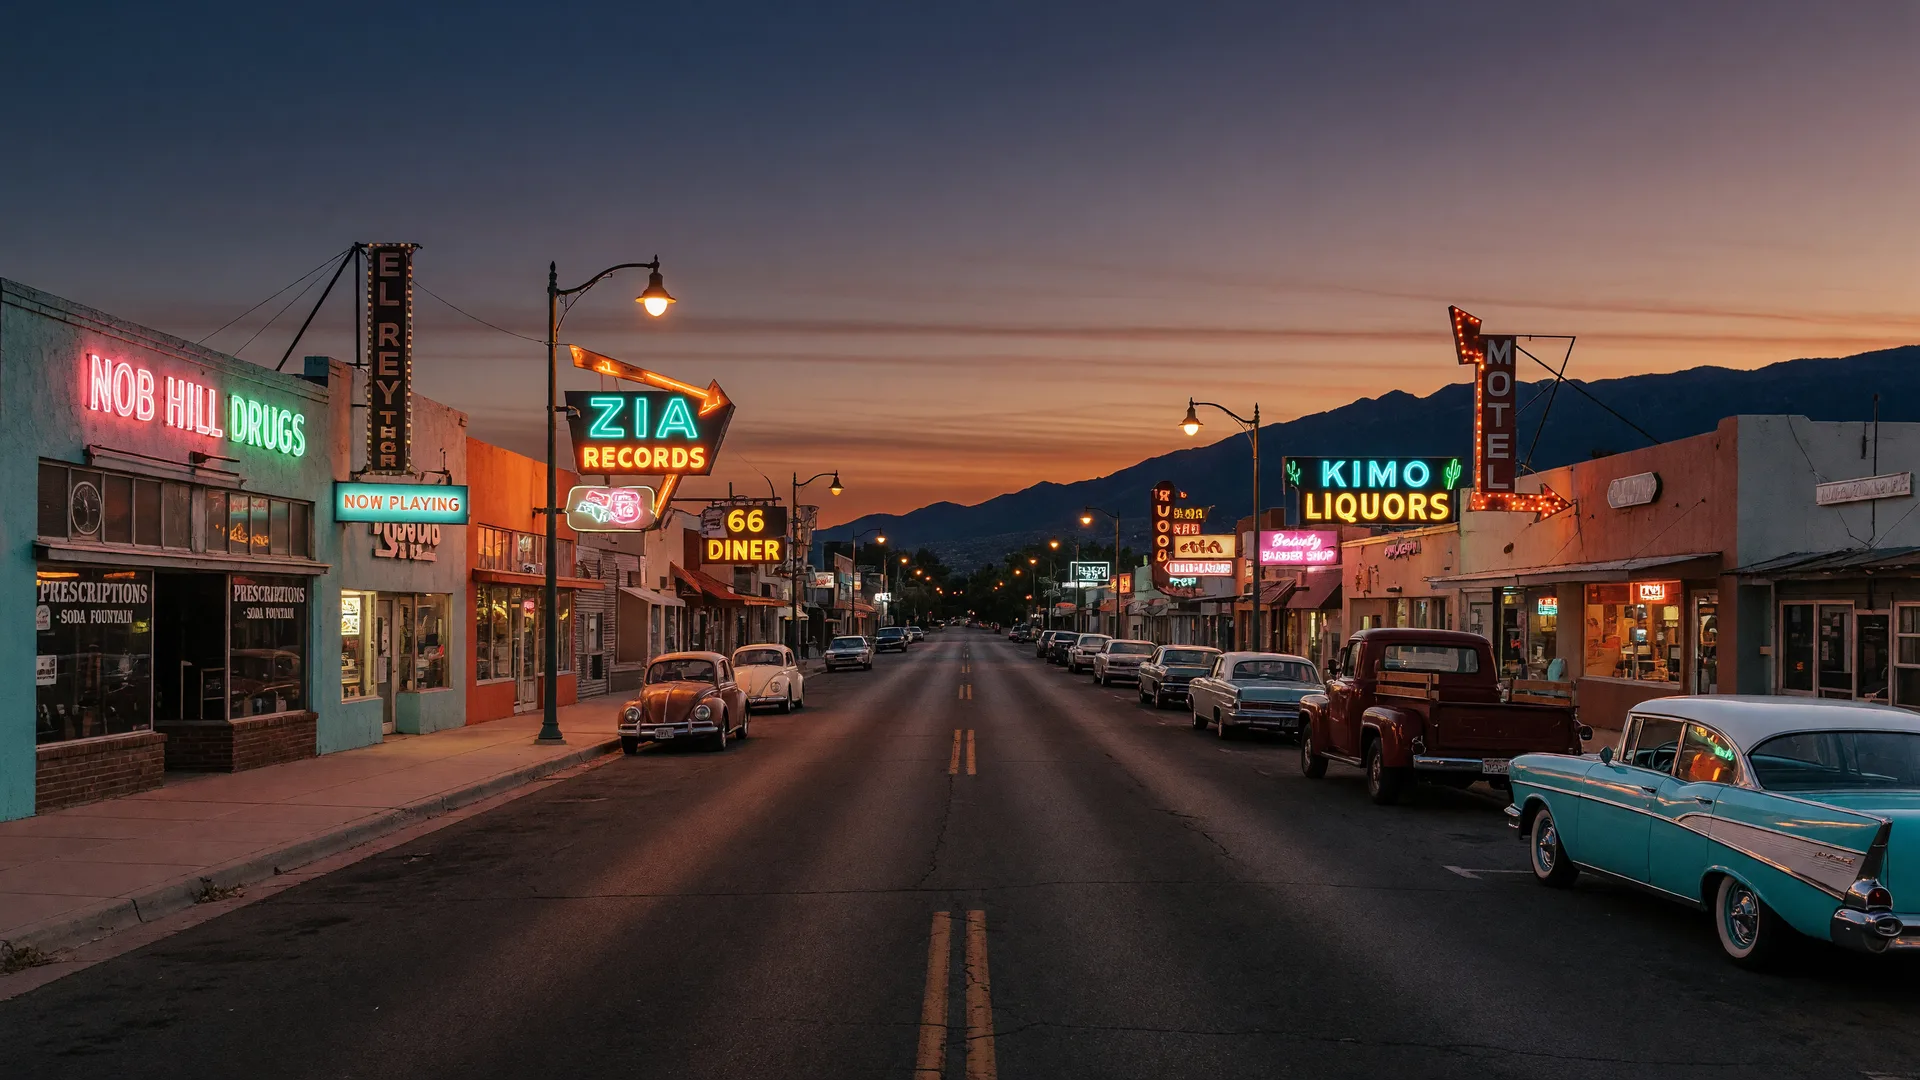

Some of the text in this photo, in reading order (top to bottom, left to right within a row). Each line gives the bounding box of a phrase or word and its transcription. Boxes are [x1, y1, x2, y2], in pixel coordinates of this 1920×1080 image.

[379, 252, 400, 307] EL
[376, 322, 402, 405] REY
[90, 354, 306, 457] NOB HILL DRUGS
[1486, 339, 1512, 489] MOTEL
[590, 397, 698, 438] ZIA
[583, 446, 705, 468] RECORDS
[1322, 460, 1430, 488] KIMO
[344, 494, 460, 512] NOW PLAYING
[1306, 492, 1449, 523] LIQUORS
[727, 509, 765, 532] 66
[708, 539, 780, 560] DINER
[1271, 533, 1322, 551] Beauty
[1262, 550, 1335, 562] BARBER SHOP
[39, 581, 148, 604] PRESCRIPTIONS
[233, 584, 305, 603] PRESCRIPTIONS
[60, 609, 86, 624] SODA
[246, 607, 264, 619] SODA
